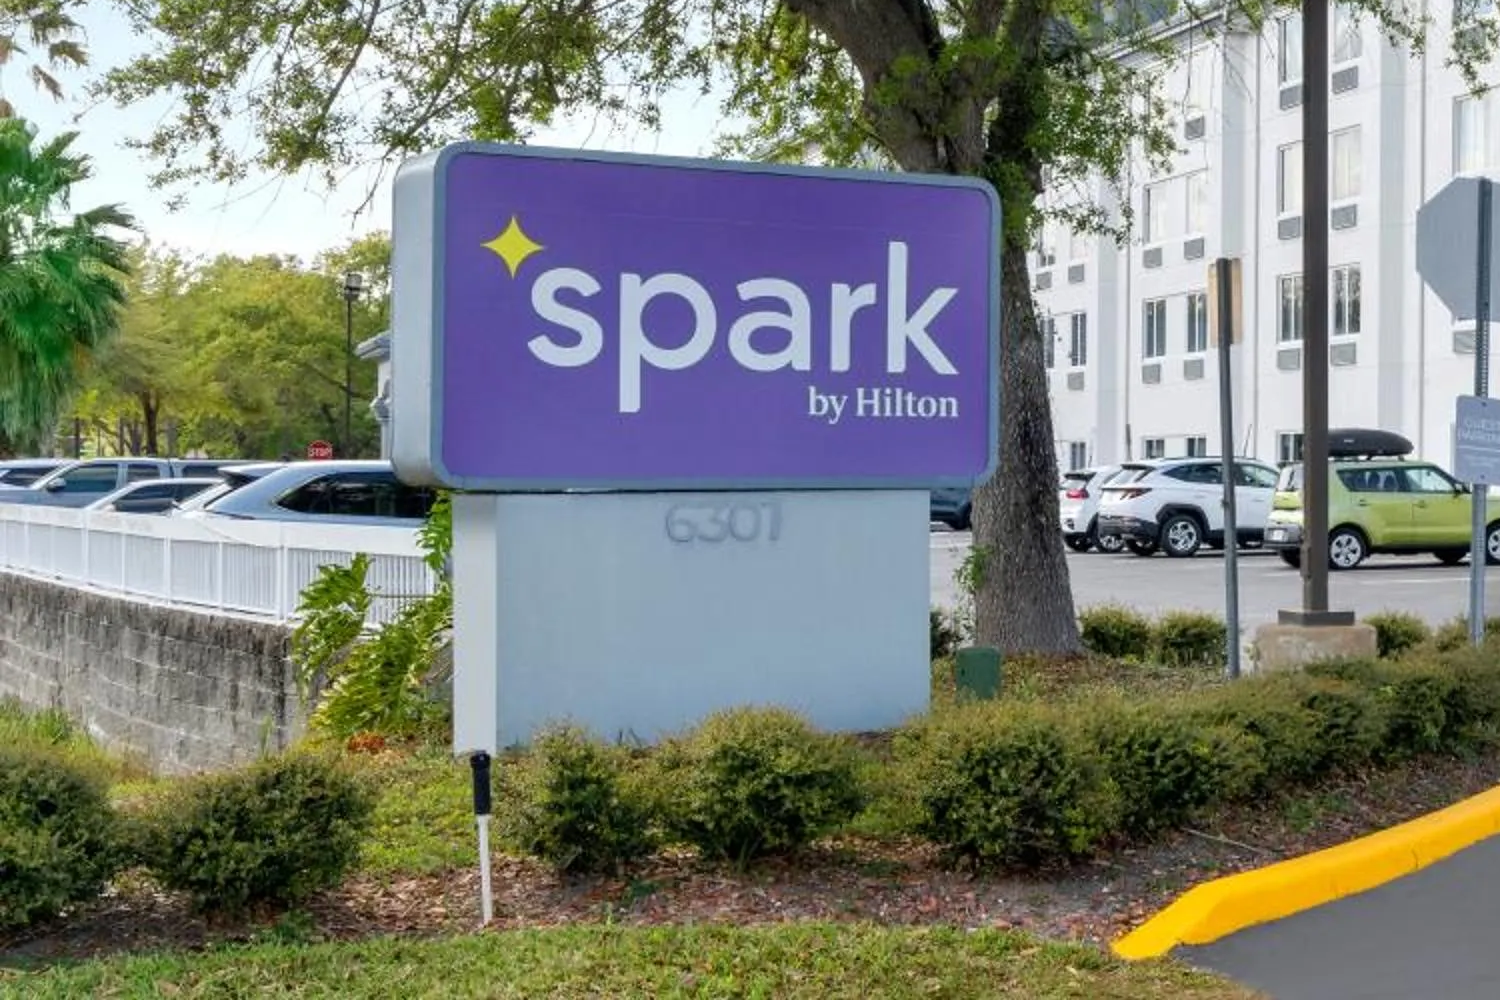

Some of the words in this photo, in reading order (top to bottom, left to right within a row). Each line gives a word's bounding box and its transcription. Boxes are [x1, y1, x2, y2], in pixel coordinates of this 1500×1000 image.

[527, 241, 959, 413] spark
[808, 385, 848, 425] by
[855, 387, 960, 418] Hilton
[665, 502, 783, 542] 6301
